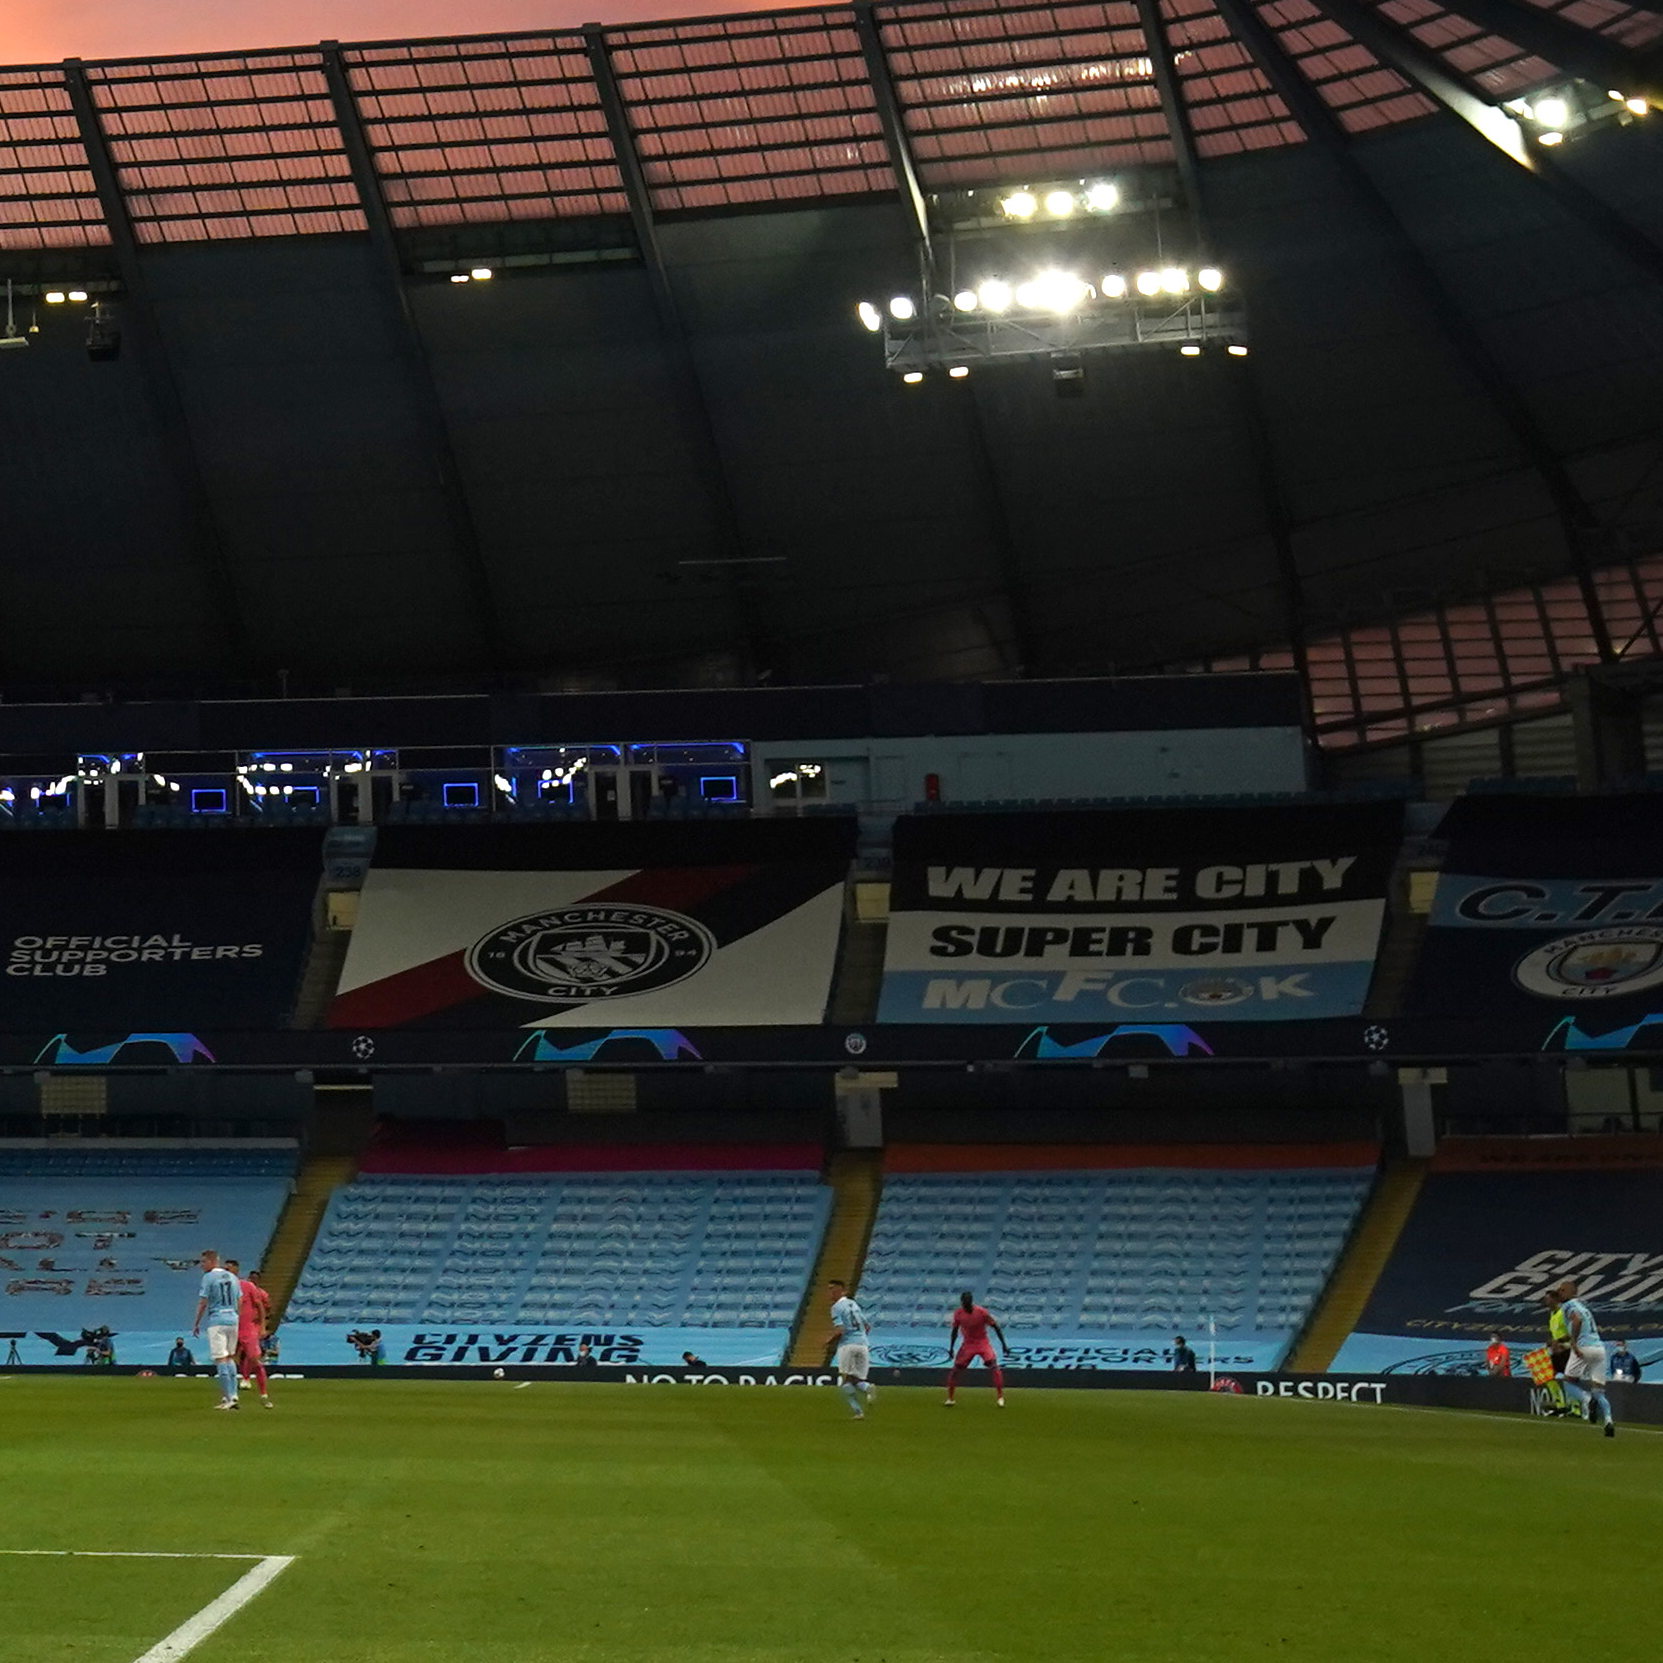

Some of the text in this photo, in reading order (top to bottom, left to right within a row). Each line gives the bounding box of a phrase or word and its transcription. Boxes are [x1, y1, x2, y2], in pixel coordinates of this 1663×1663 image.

[926, 856, 1358, 902] WE ARE CITY
[498, 910, 691, 945] MANCHESTER
[929, 915, 1337, 958] SUPER CITY
[13, 933, 193, 949] OFFICIAL
[9, 943, 264, 963] SUPPORTERS
[5, 963, 108, 977] CLUB
[546, 985, 620, 997] CITY
[219, 1280, 232, 1307] 17
[411, 1333, 645, 1347] CITYZENS
[403, 1345, 642, 1364] GIVING
[1008, 1346, 1178, 1357] OFFICIAL
